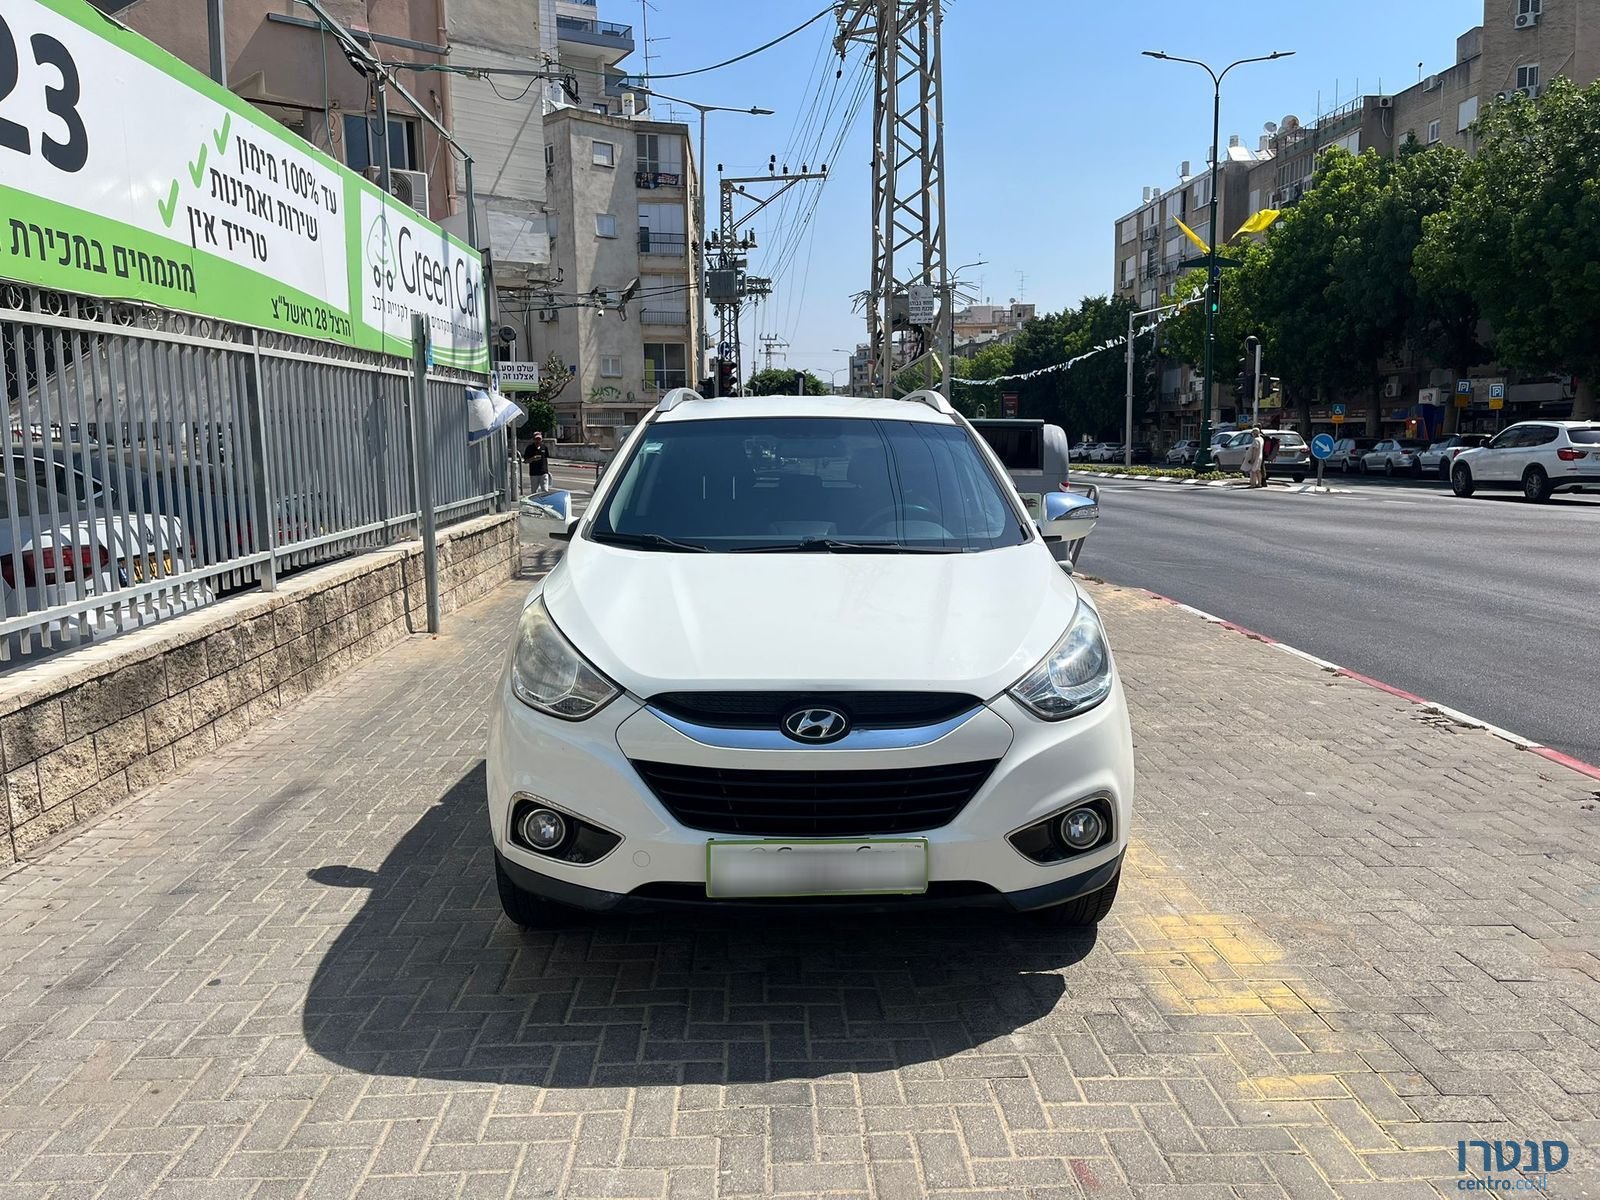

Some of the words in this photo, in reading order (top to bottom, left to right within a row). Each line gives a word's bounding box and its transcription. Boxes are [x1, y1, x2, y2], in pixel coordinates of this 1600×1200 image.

[236, 135, 279, 183] מימון
[209, 167, 274, 223] ואמינות
[281, 158, 319, 205] 100%
[320, 184, 337, 215] עד
[186, 205, 218, 249] אין
[221, 218, 267, 262] טרייד
[277, 200, 318, 242] שירות
[8, 217, 108, 274] במכירת
[112, 244, 197, 294] מתמחים
[398, 226, 454, 309] Green
[455, 257, 479, 319] Car
[314, 306, 328, 331] 28
[328, 309, 351, 337] הרצל
[513, 372, 534, 380] אצלנו
[516, 364, 534, 372] שלם
